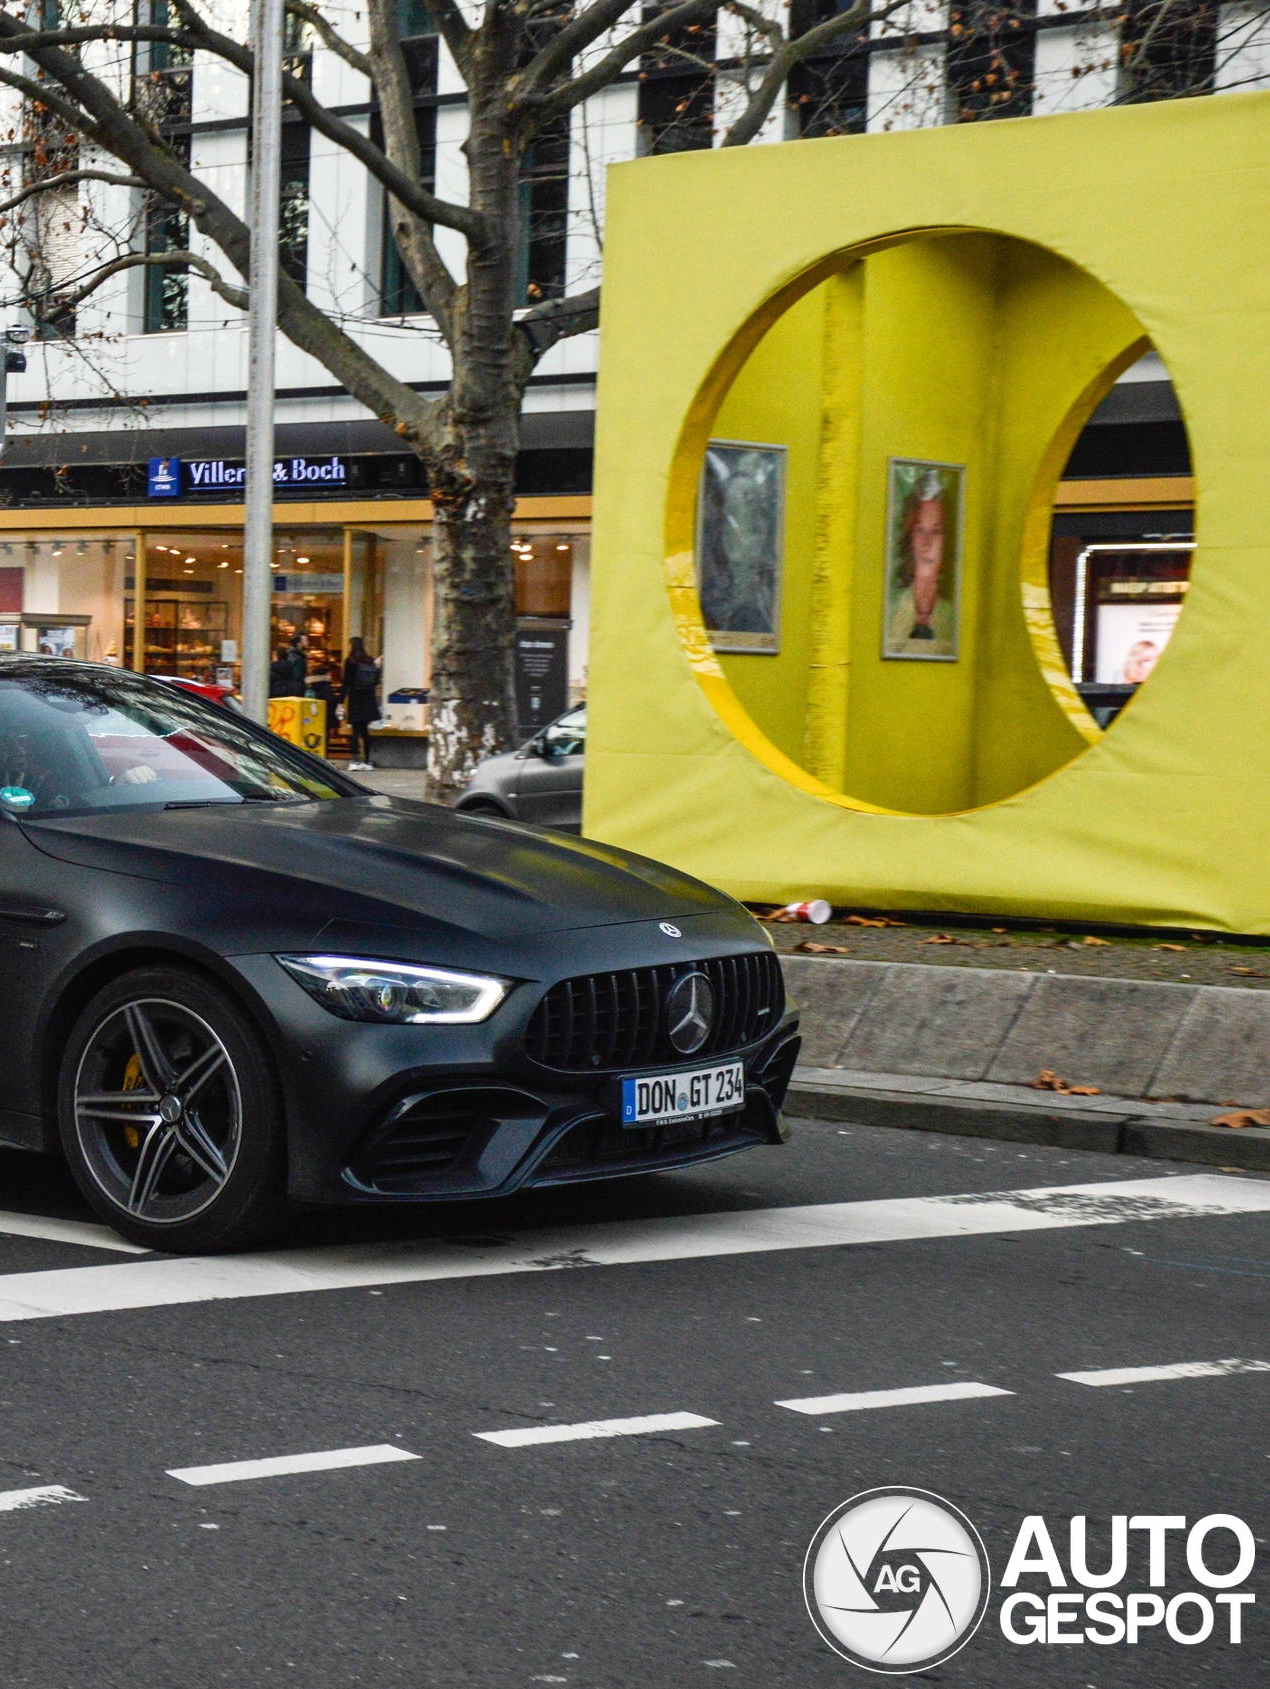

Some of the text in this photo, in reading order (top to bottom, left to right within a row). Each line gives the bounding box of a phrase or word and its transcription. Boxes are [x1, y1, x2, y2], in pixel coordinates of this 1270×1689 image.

[190, 457, 345, 484] Viller & Boch
[637, 1067, 743, 1116] DON GT 234
[626, 1105, 633, 1116] D
